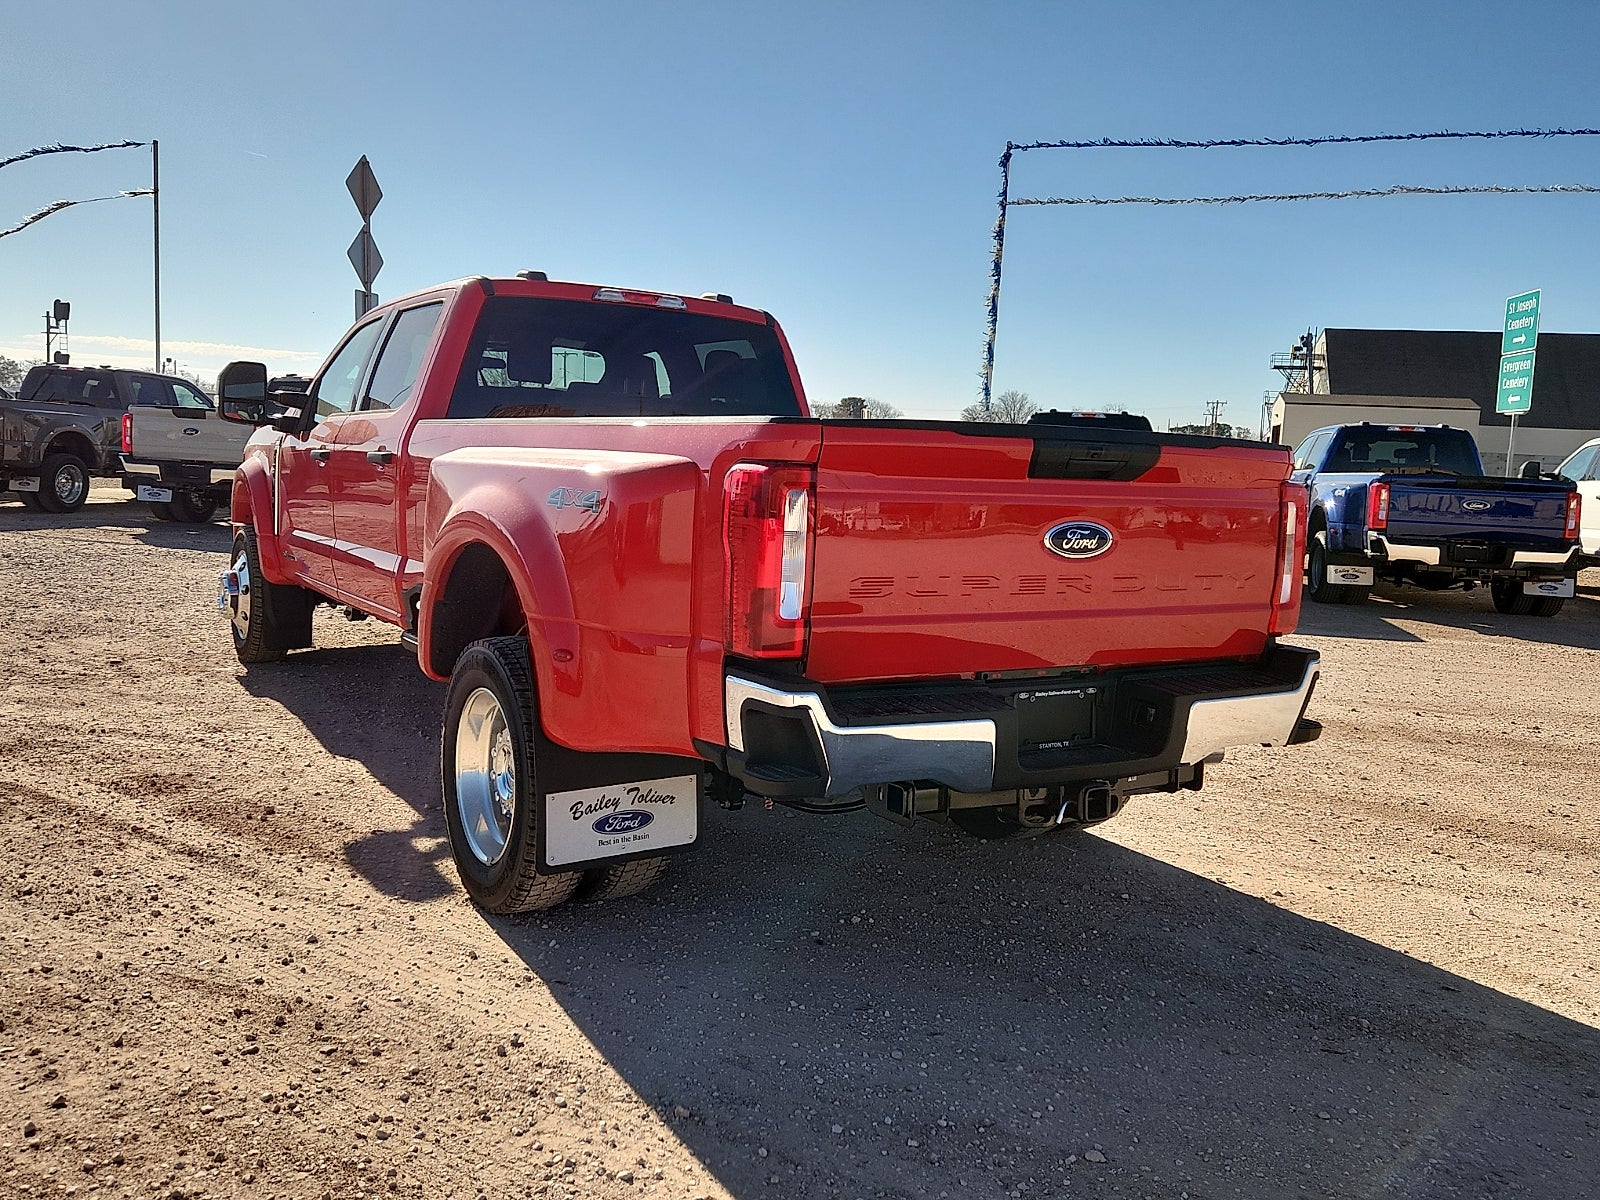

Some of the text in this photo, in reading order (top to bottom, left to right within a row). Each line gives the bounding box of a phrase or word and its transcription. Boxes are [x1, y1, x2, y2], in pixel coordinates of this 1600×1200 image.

[1509, 297, 1536, 314] St Joseph
[1507, 315, 1534, 330] Cemetery
[1503, 360, 1530, 373] Evergreen
[1502, 376, 1528, 389] Cemetery
[1062, 528, 1100, 549] Ford
[849, 574, 1256, 598] SUPER DUTY
[569, 786, 676, 821] Bailey Toliver
[604, 813, 641, 832] Ford
[598, 838, 612, 847] Best
[621, 835, 631, 843] the
[632, 832, 650, 841] Basin
